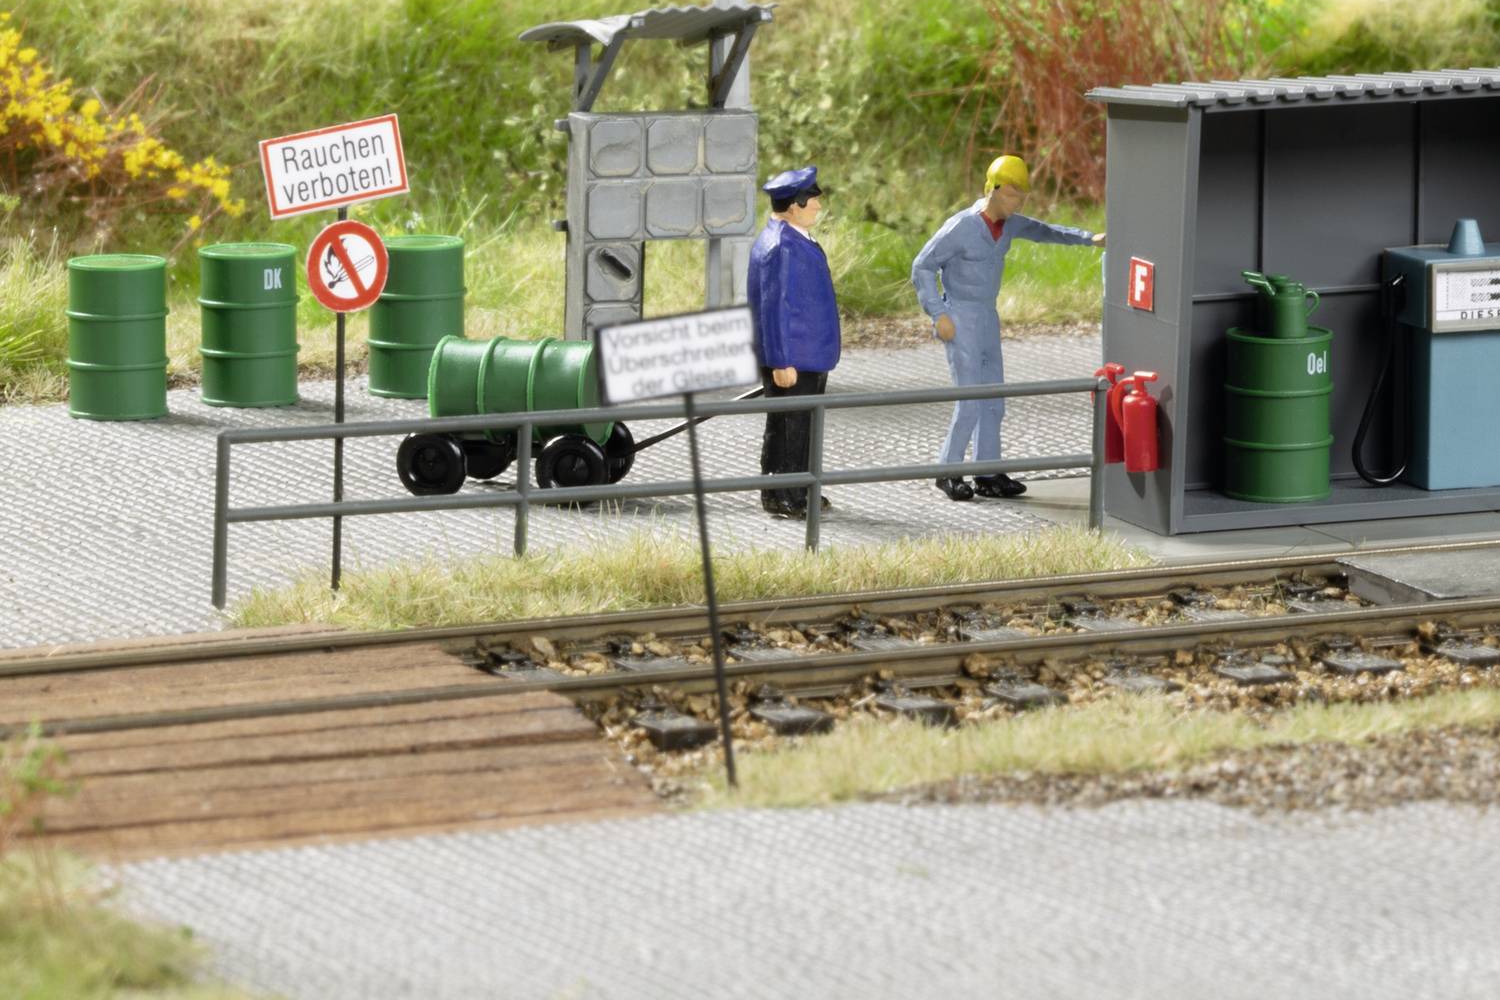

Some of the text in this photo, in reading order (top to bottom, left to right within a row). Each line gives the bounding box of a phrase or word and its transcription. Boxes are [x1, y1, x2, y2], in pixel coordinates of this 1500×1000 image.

[281, 134, 385, 174] Rauchen
[283, 158, 393, 204] verboten!
[263, 268, 282, 290] DK
[1134, 264, 1148, 302] F
[606, 316, 748, 350] Vorsicht beim
[1307, 350, 1327, 375] Oel
[632, 367, 737, 396] der Gleise
